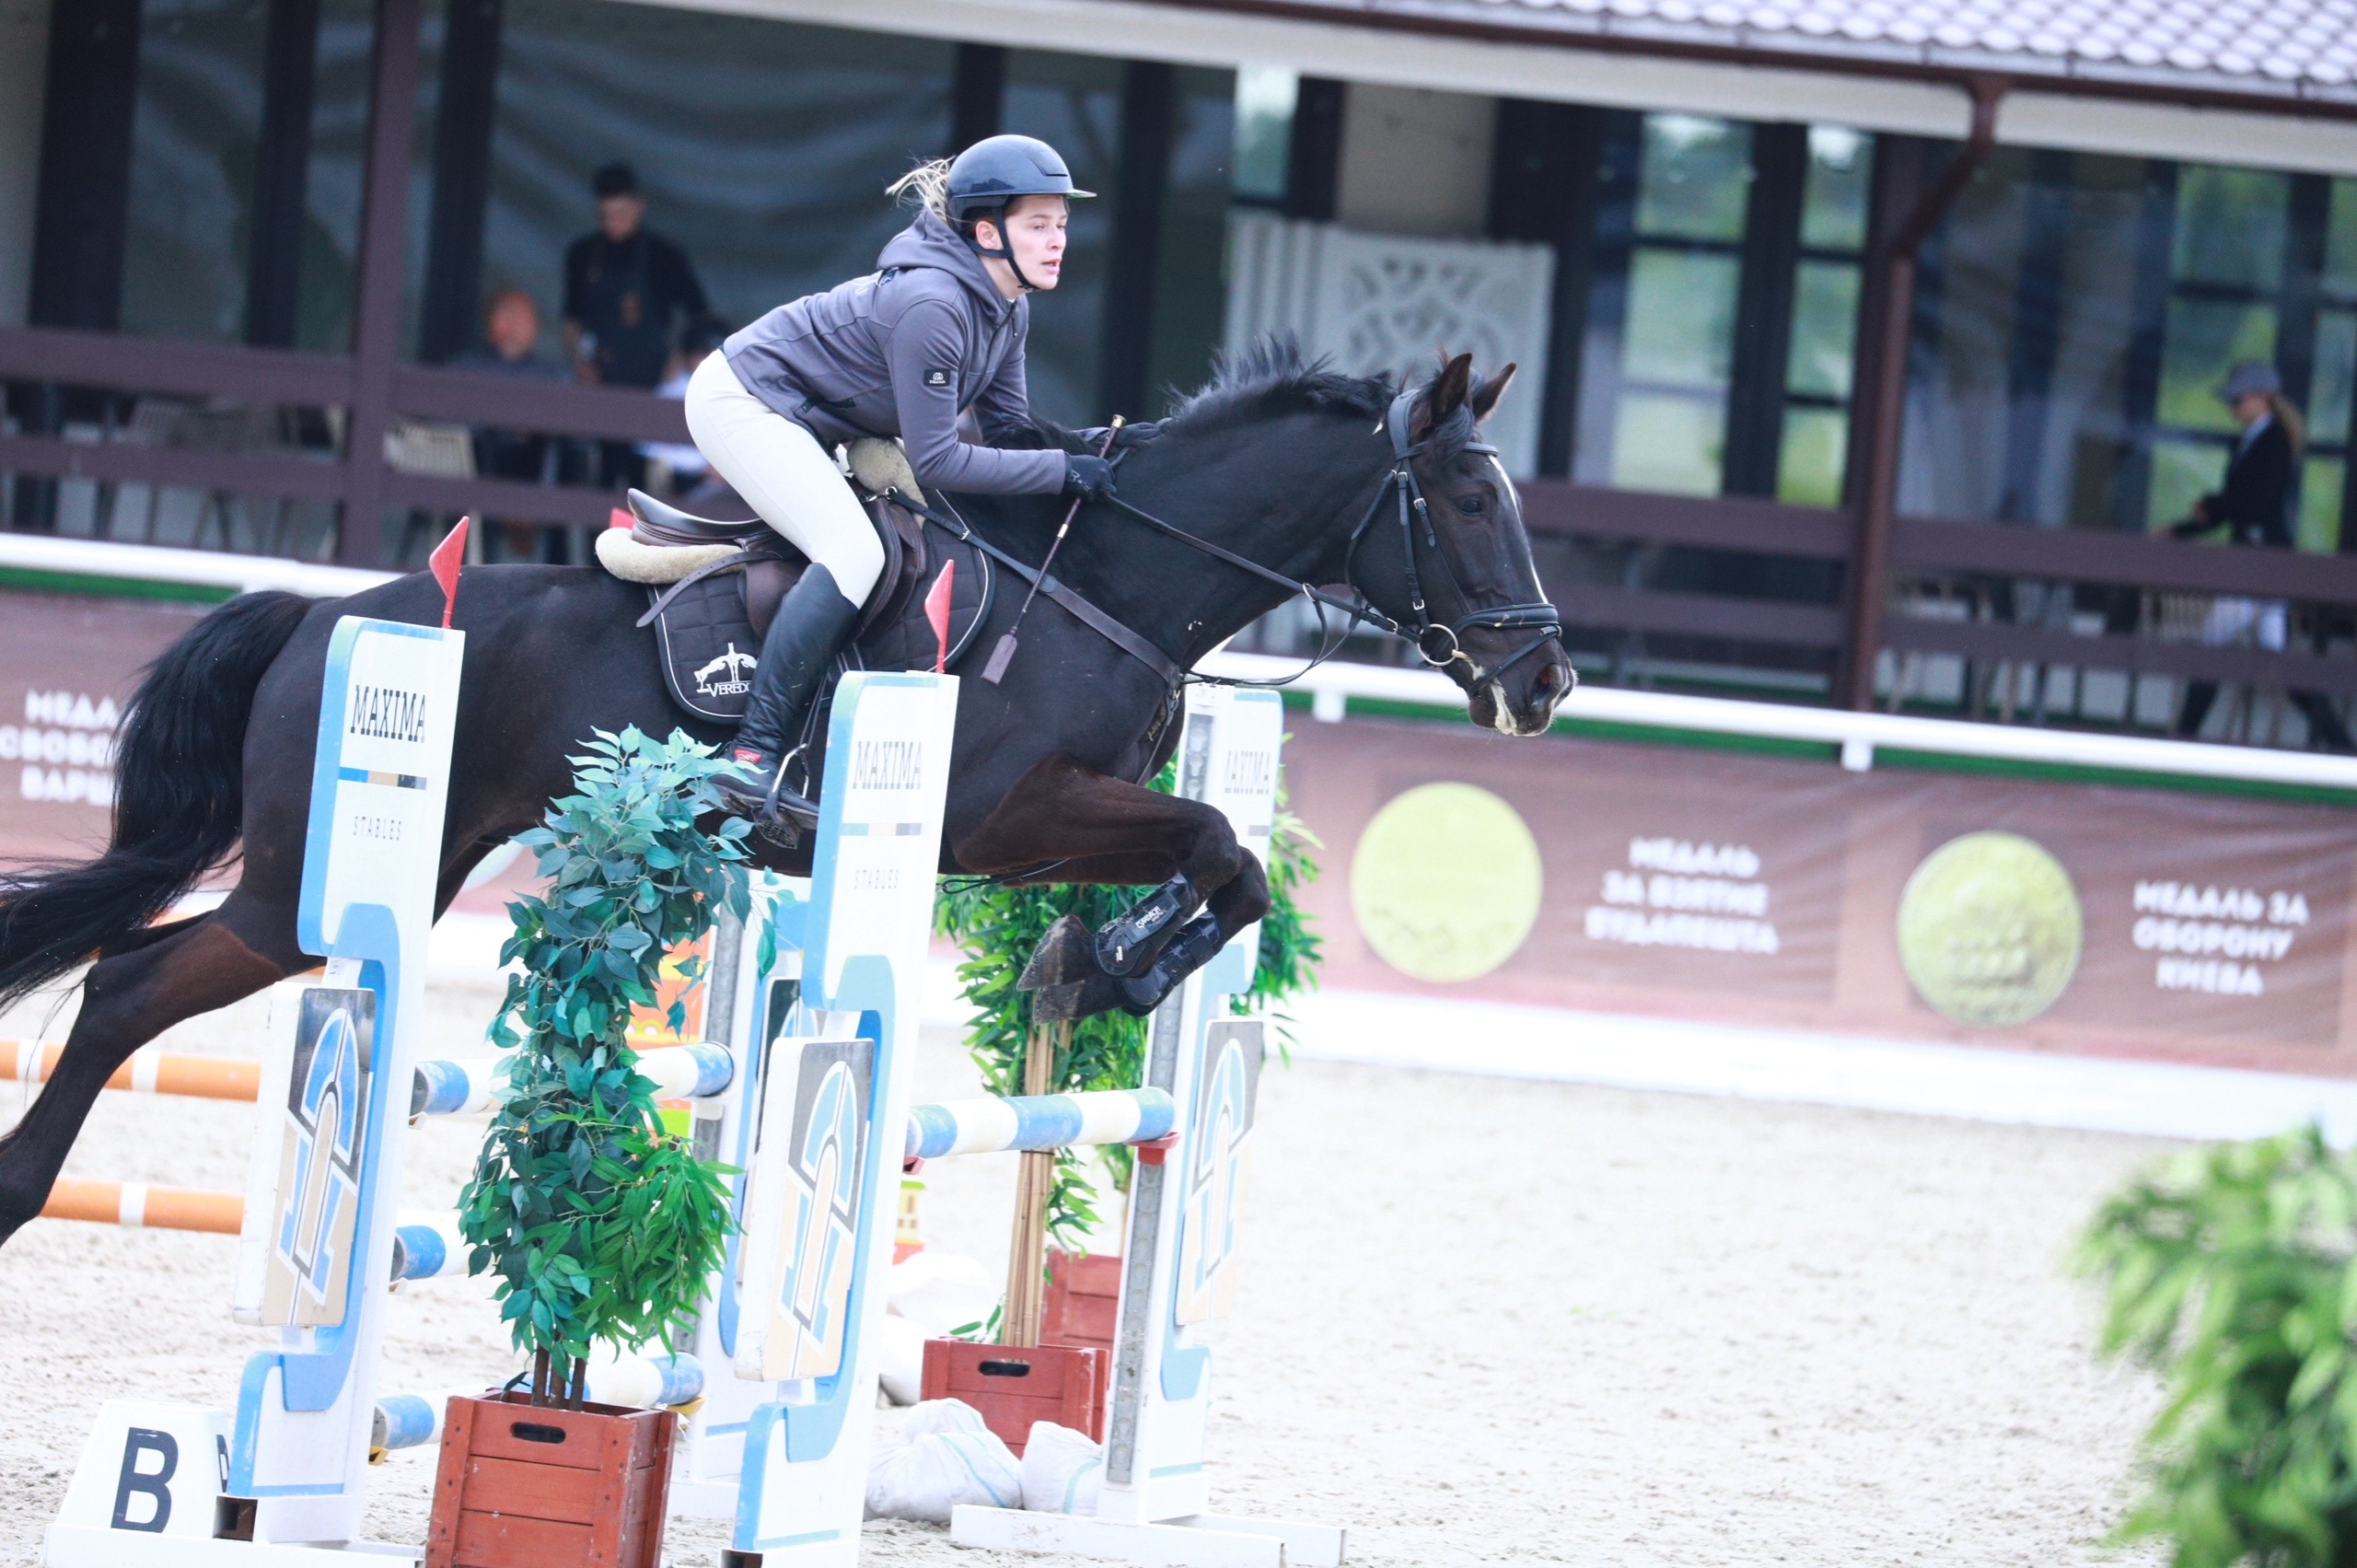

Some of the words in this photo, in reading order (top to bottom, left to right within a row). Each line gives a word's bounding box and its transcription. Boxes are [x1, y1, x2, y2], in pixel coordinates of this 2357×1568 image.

[26, 690, 119, 728] МЕДА
[705, 682, 750, 697] VERED
[350, 684, 425, 742] MAXIMA
[853, 741, 921, 789] MAXIMA
[353, 816, 401, 841] STABLES
[2134, 883, 2264, 920] МЕДАЛЬ
[2270, 893, 2308, 923] ЗА
[2133, 917, 2293, 958] ОБОРОНУ
[110, 1427, 179, 1533] B
